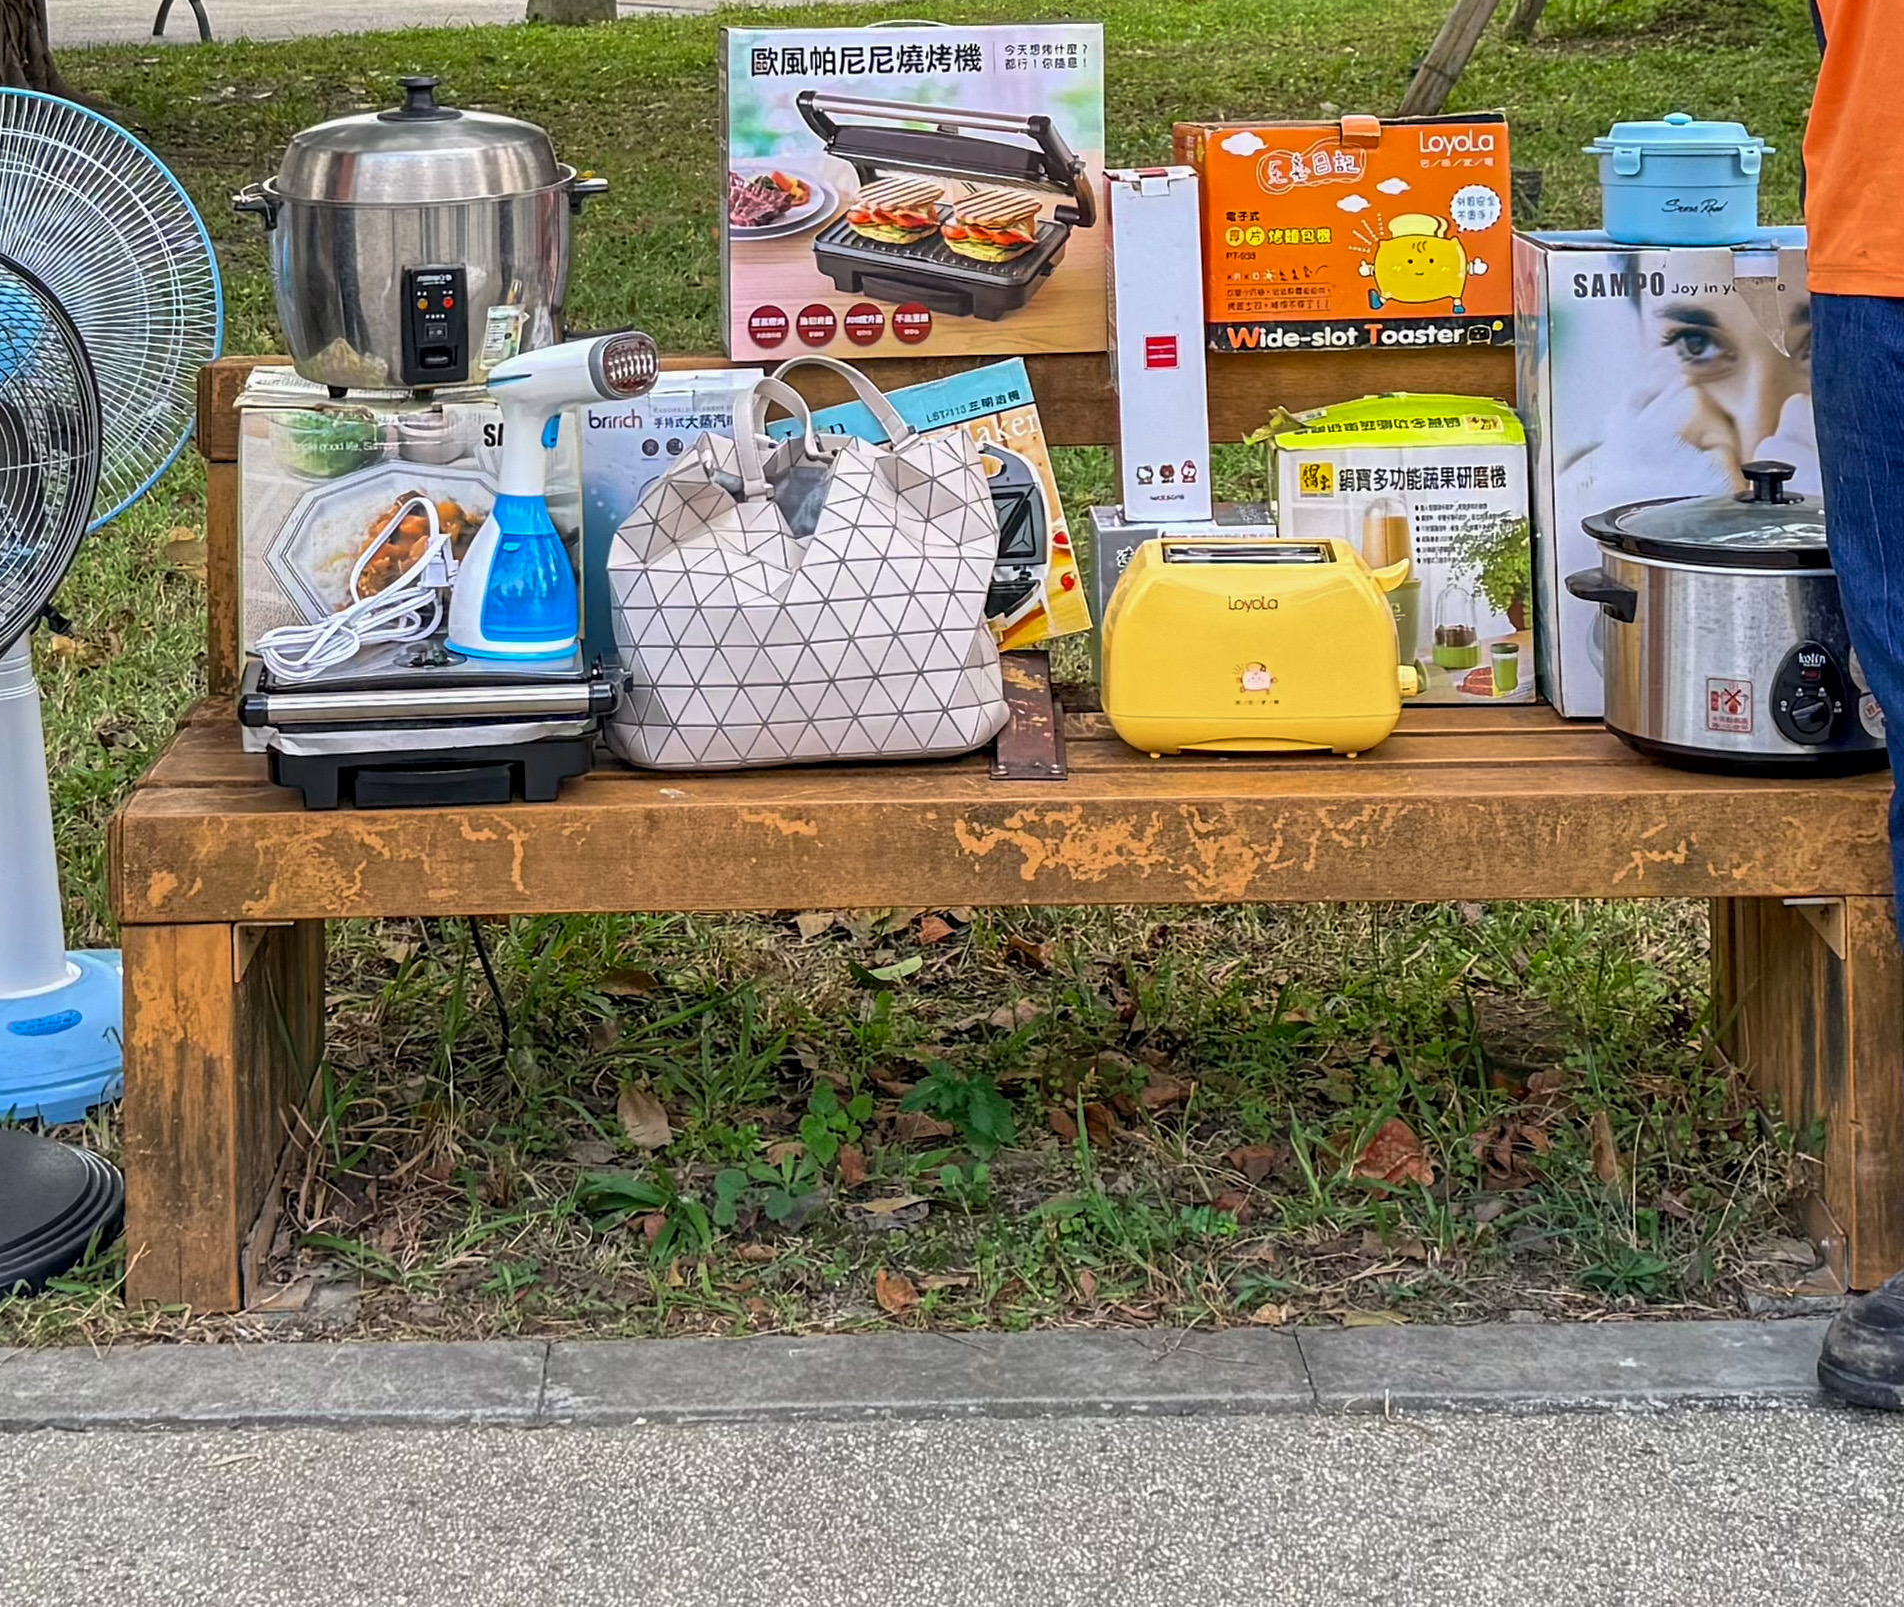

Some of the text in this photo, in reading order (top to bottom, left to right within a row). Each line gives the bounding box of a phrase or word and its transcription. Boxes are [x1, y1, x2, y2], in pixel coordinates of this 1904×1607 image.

[751, 43, 983, 78] 歐風帕尼尼燒烤機
[1419, 130, 1494, 155] LoyoLa
[1226, 211, 1260, 222] 電子式
[1573, 272, 1665, 298] SAMPO
[1671, 283, 1698, 296] Joy
[1704, 283, 1718, 293] in
[1226, 323, 1464, 349] Wide-slot Toaster
[1338, 465, 1507, 492] 鍋寶多功能蔬果研磨機
[1228, 595, 1278, 613] LoyoLa
